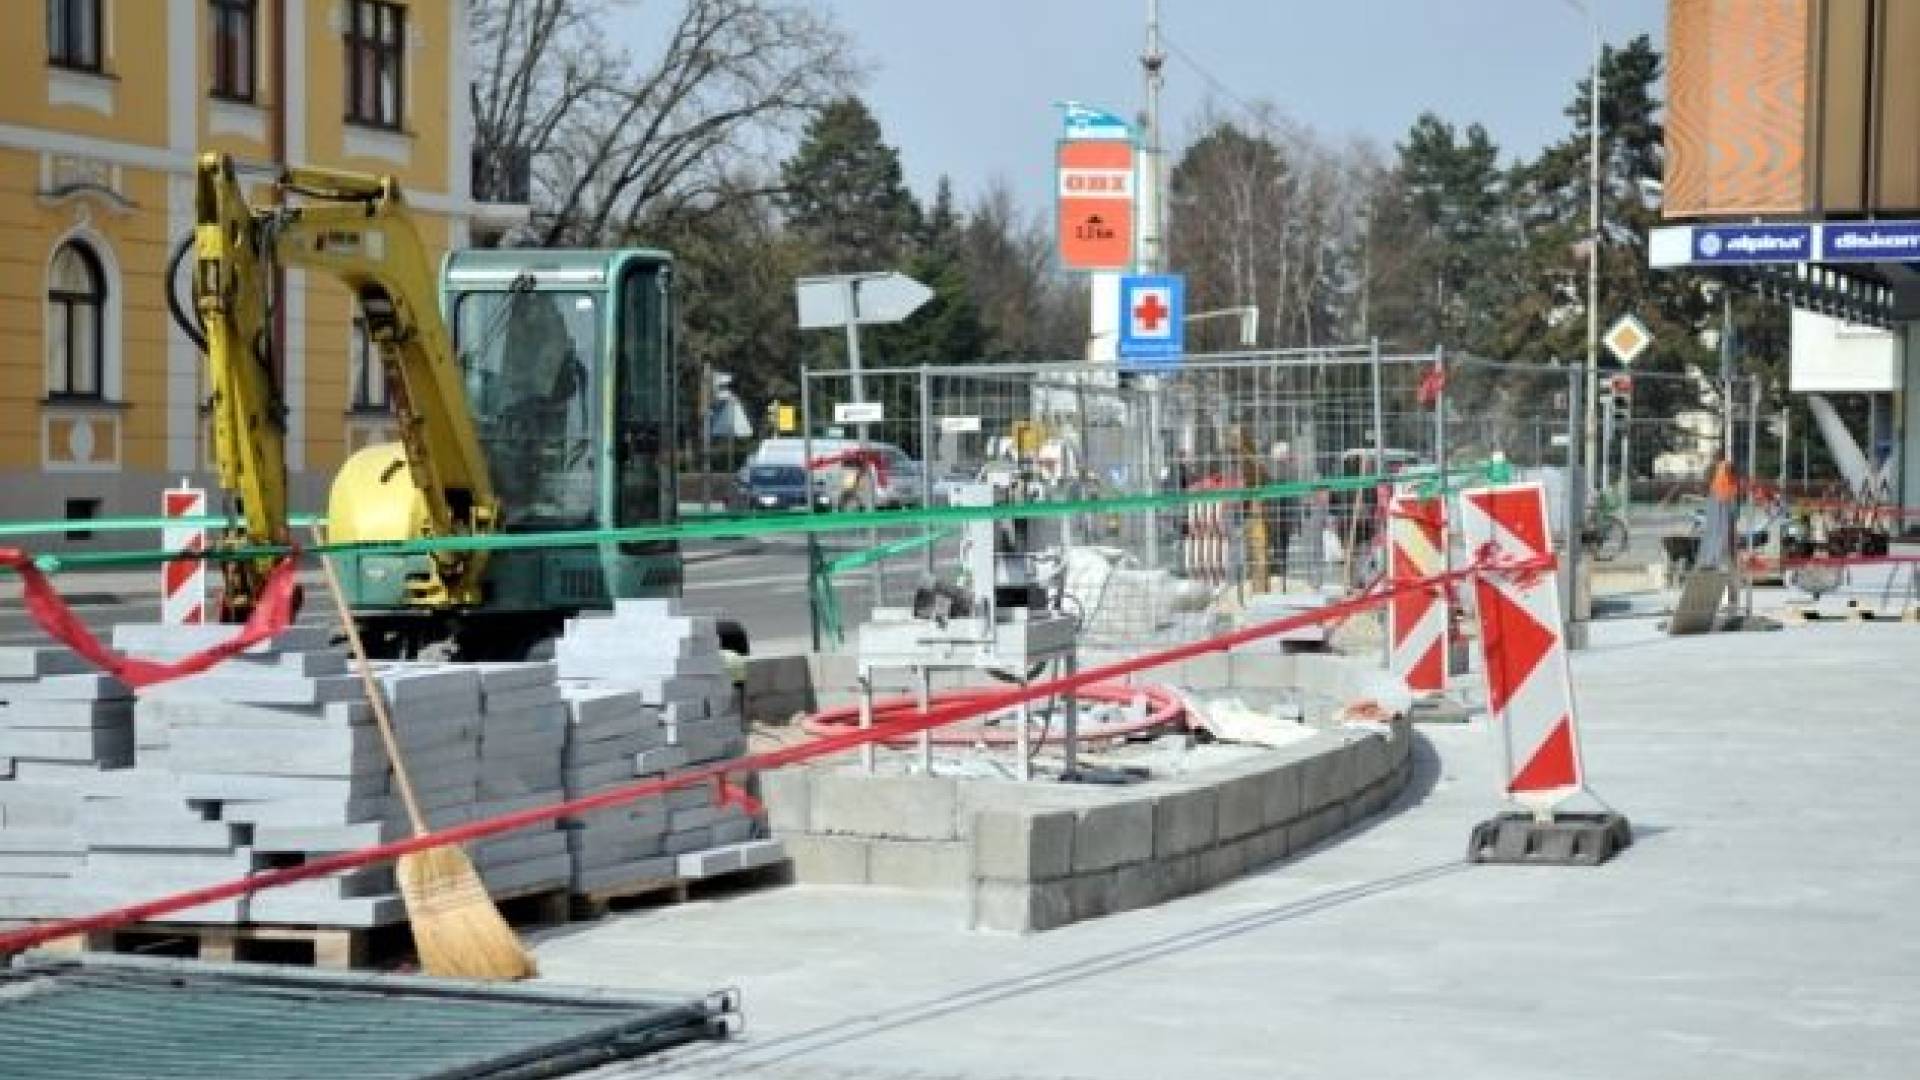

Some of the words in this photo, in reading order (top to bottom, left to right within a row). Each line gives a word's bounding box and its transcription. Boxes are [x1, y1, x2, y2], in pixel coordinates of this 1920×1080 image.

[1065, 174, 1123, 191] OBI
[1727, 233, 1800, 254] alpina
[1834, 231, 1920, 248] diskon
